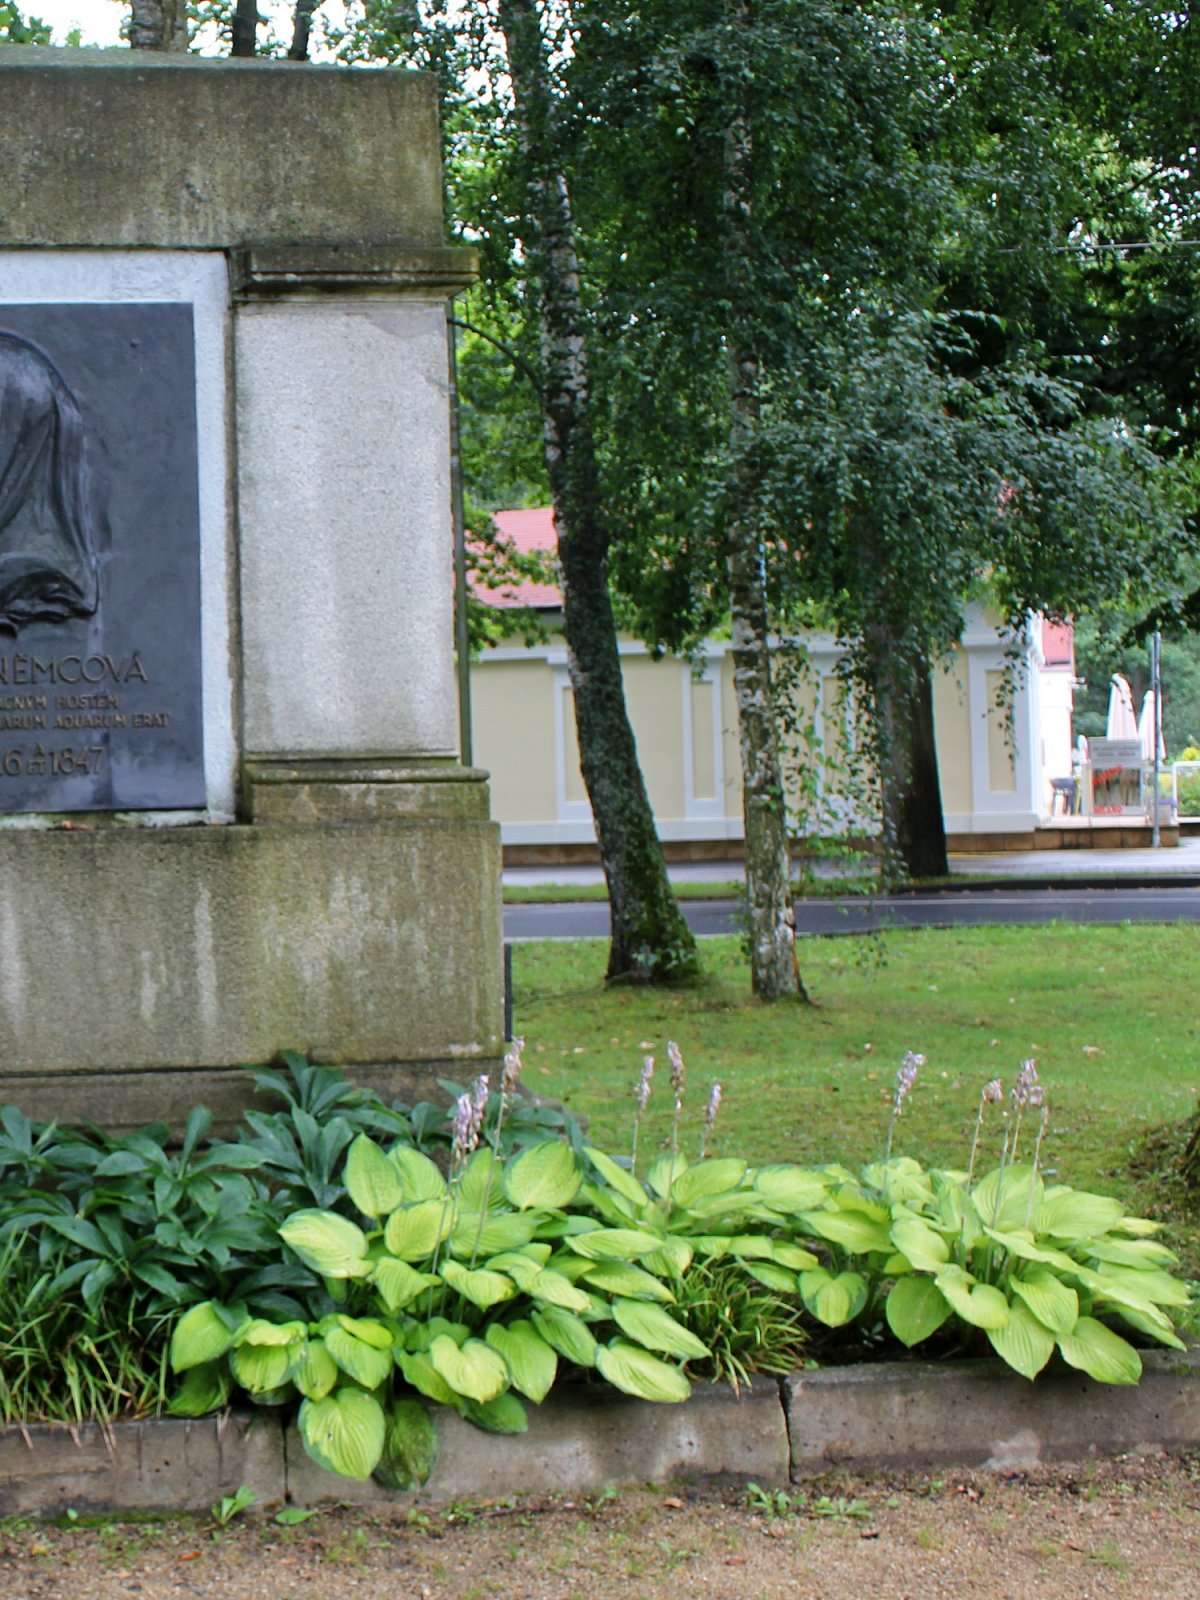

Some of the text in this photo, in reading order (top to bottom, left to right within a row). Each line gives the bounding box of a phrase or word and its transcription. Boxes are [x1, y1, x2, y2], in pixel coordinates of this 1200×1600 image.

[132, 712, 170, 728] ERAT
[27, 759, 47, 775] ET
[48, 746, 105, 775] 1847
